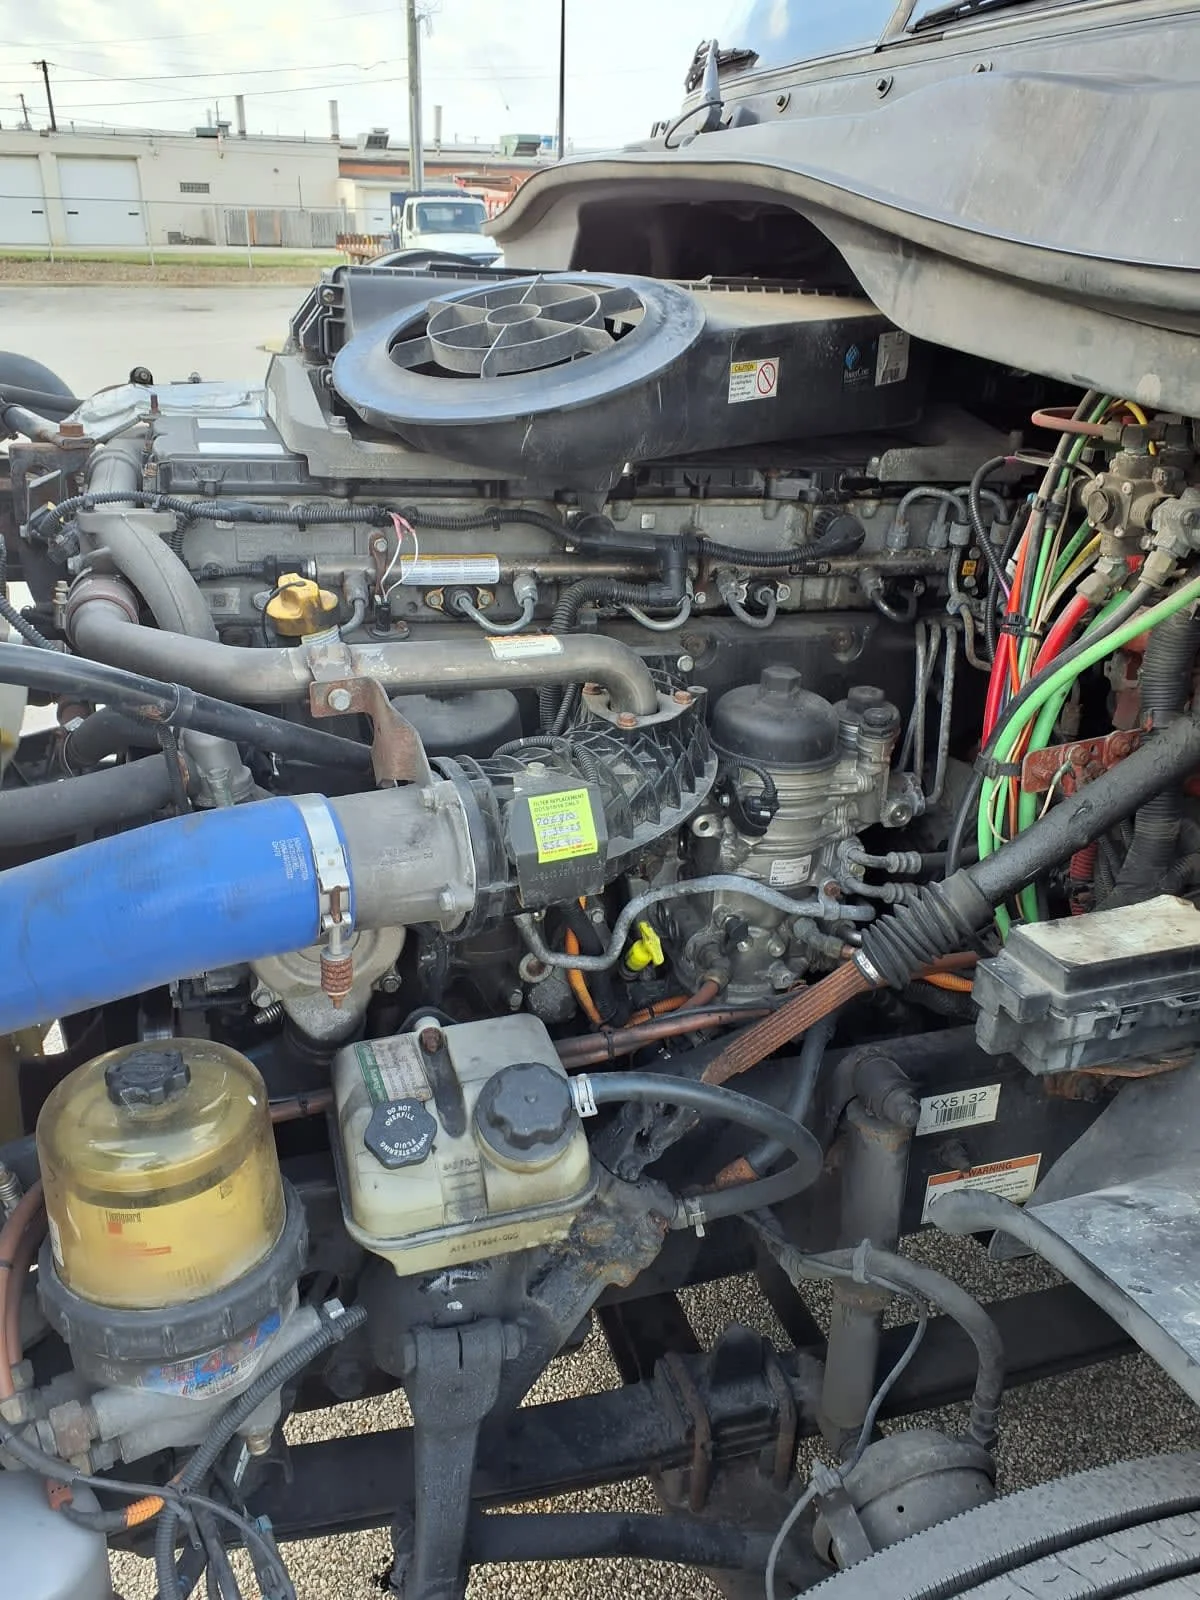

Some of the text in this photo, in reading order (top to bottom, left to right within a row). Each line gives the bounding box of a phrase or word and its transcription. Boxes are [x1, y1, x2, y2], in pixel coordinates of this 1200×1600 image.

[930, 1091, 987, 1111] KX5132
[387, 1107, 396, 1115] DO
[385, 1112, 415, 1126] OVERFILL
[380, 1133, 429, 1156] POWER STEERING
[394, 1138, 416, 1149] FLUID
[969, 1161, 1012, 1177] WARNING
